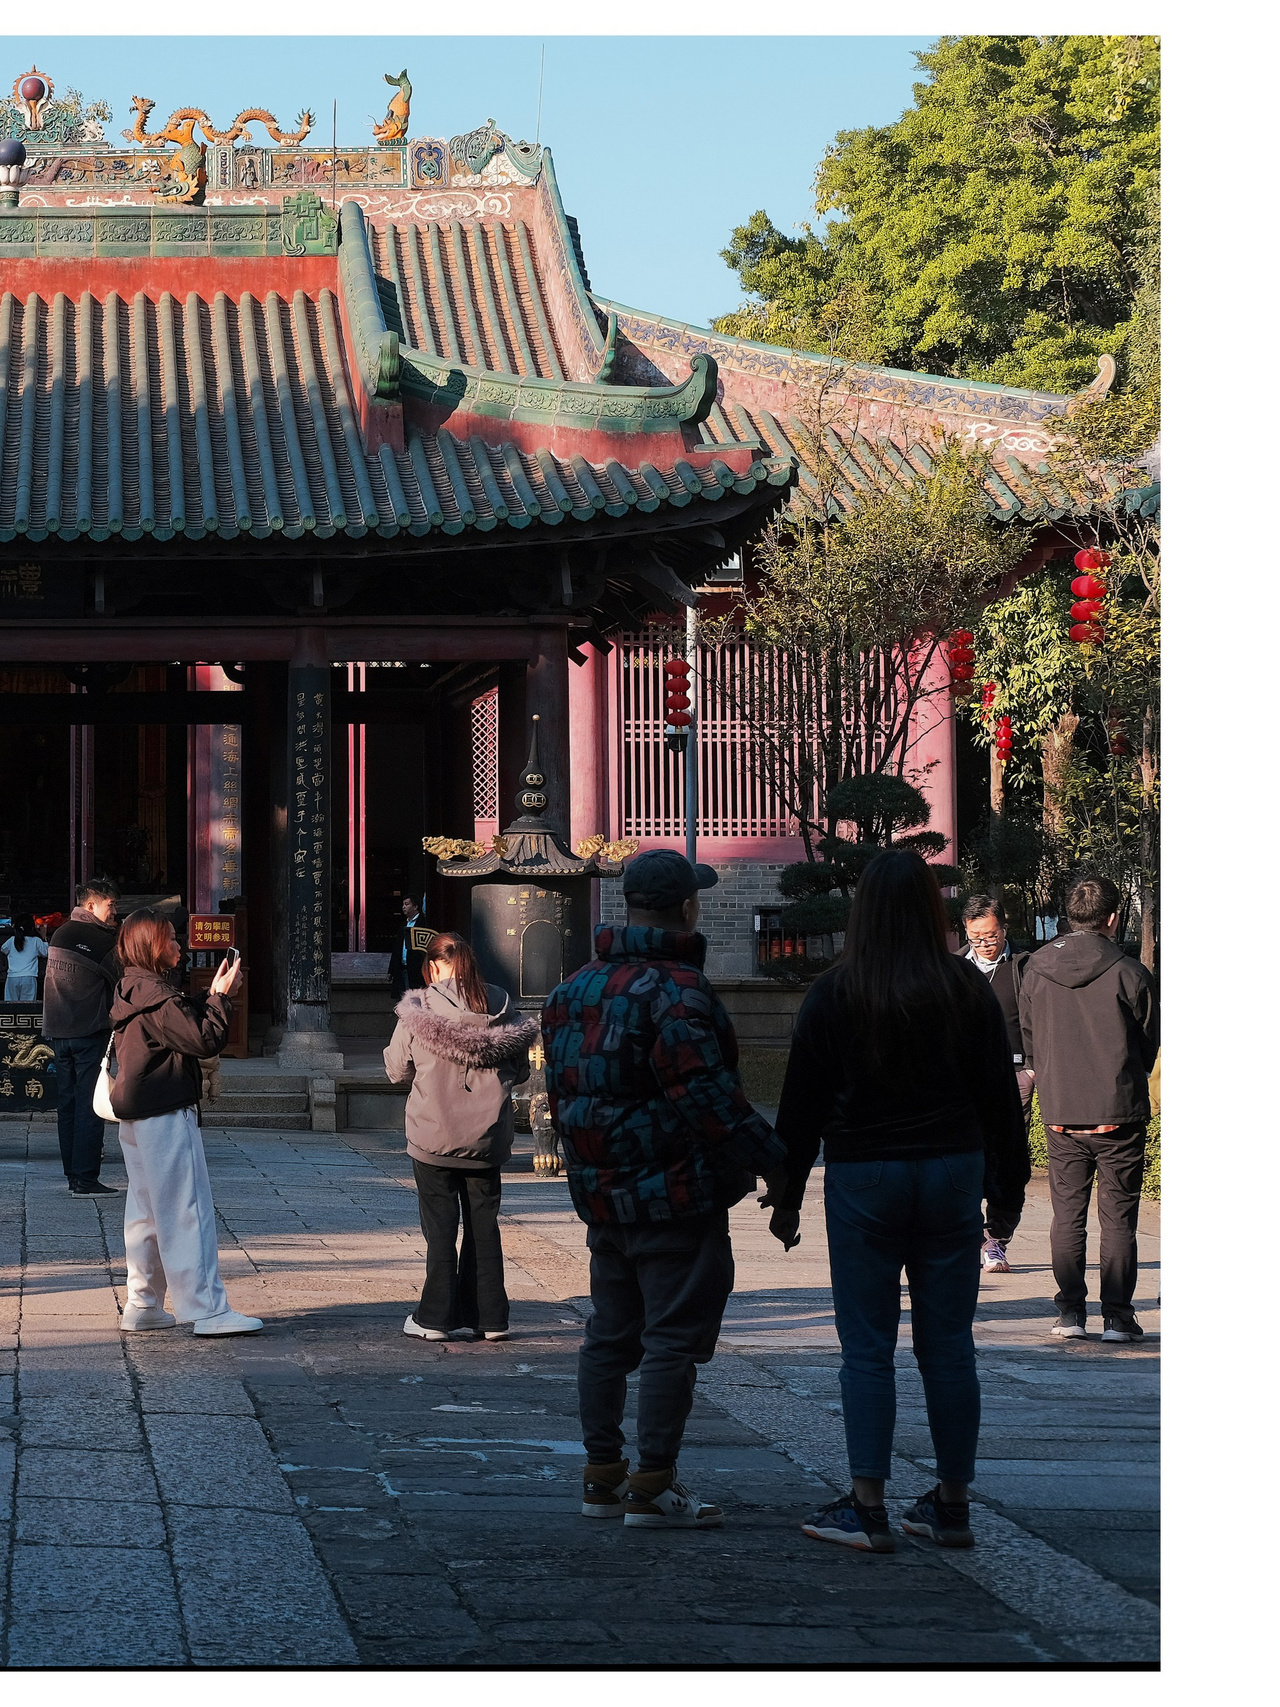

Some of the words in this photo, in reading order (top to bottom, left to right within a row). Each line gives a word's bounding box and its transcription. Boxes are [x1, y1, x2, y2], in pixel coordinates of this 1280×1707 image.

[195, 921, 231, 931] 请勿攀爬
[195, 932, 231, 942] 文明参观
